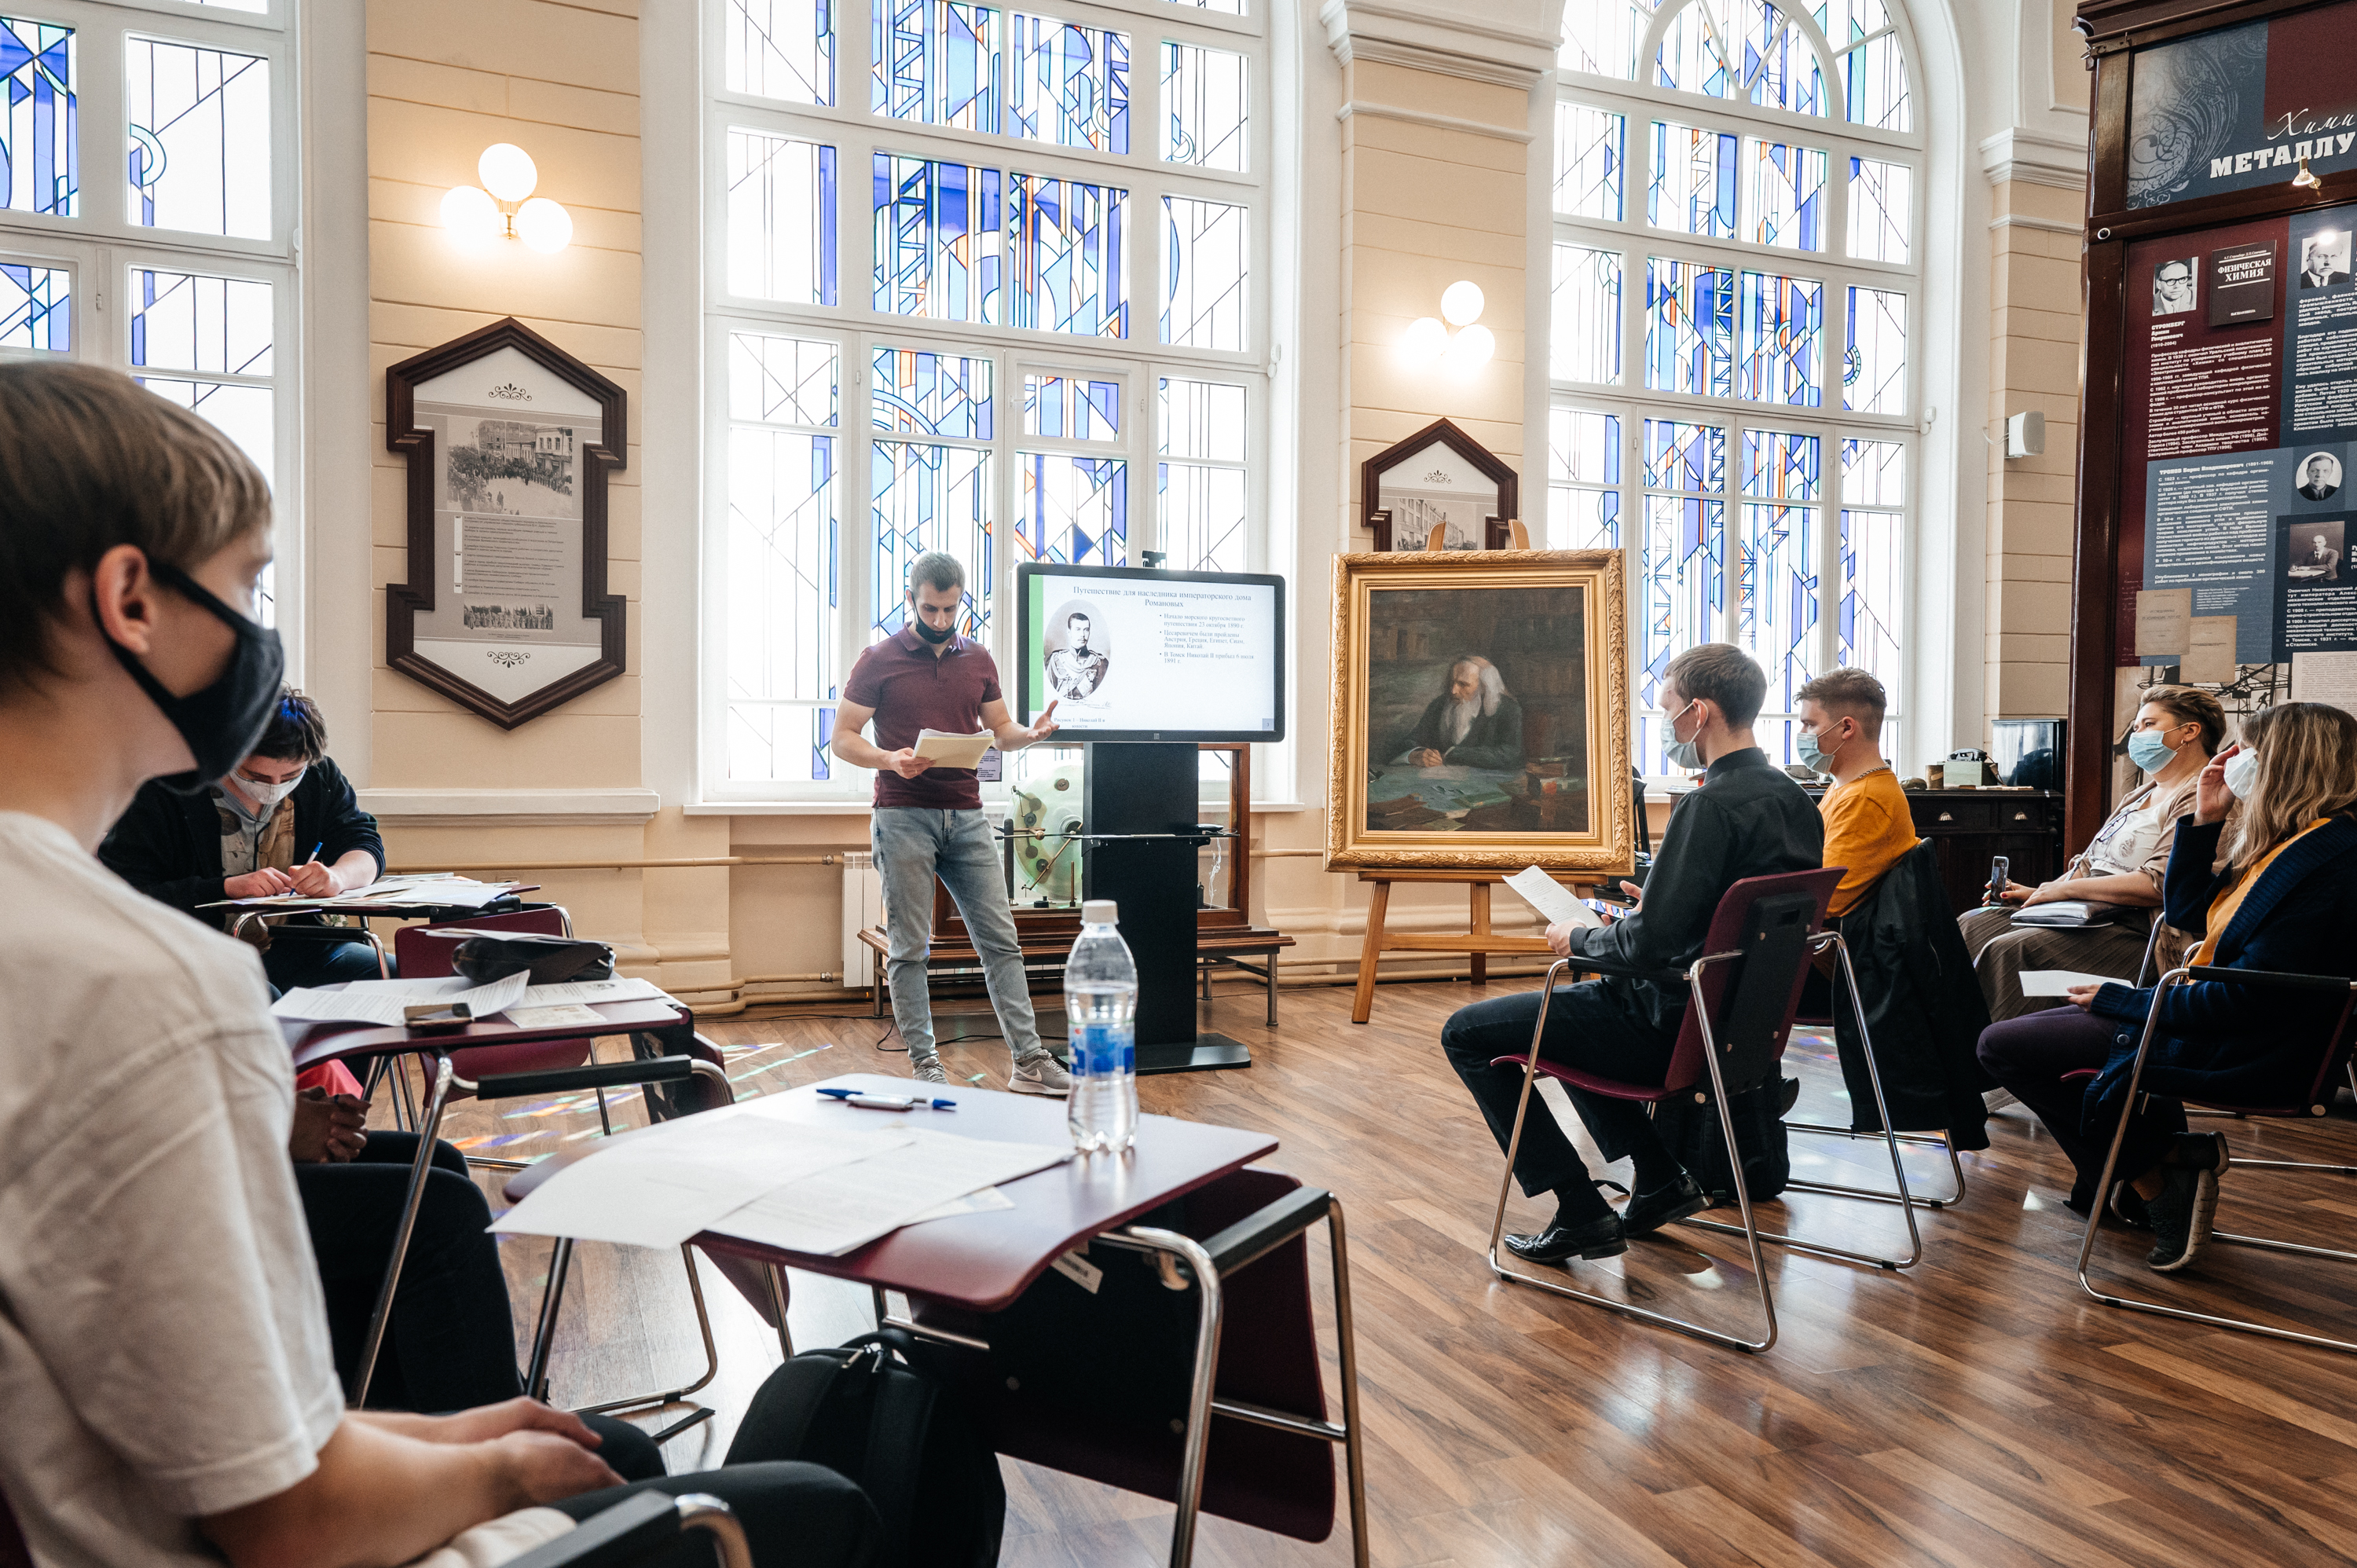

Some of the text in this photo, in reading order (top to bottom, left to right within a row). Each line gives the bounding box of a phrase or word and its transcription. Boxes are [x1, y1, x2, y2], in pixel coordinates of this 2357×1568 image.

[2267, 108, 2355, 140] Хими
[2210, 132, 2356, 178] МЕТАЛЛУ
[2218, 258, 2271, 274] ФИЗИЧЕСКАЯ
[2225, 268, 2264, 282] ХИМИЯ
[2151, 321, 2185, 330] СТРОМБЕРГ
[1073, 587, 1121, 595] Путешествие
[1179, 592, 1233, 600] императорского
